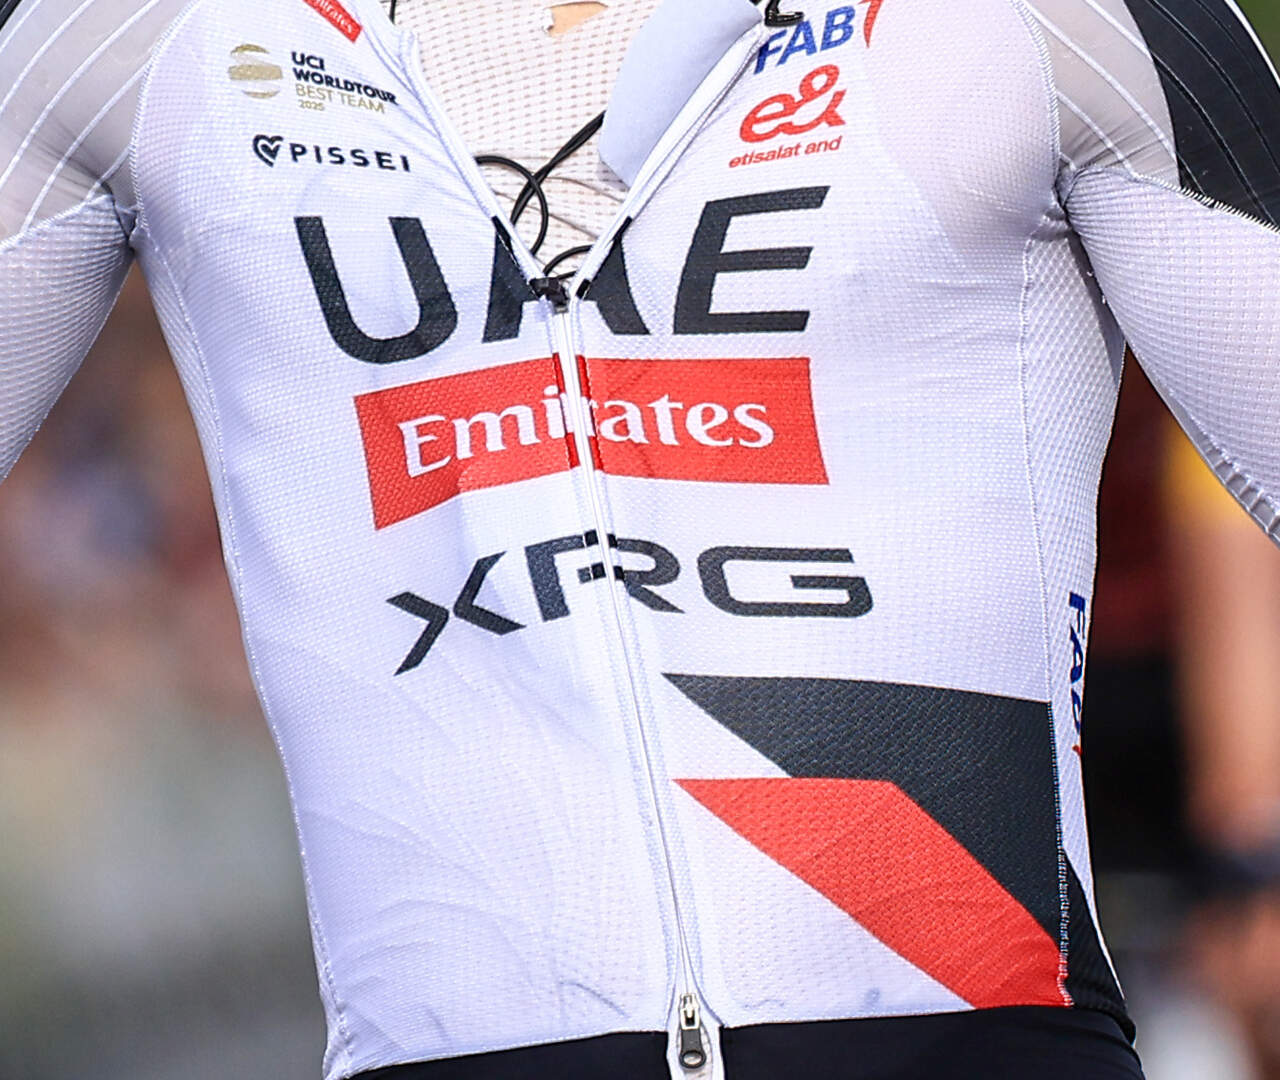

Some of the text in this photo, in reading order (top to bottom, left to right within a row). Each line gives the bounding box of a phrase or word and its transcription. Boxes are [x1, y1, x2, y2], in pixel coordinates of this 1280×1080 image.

[291, 51, 325, 71] UCI
[293, 67, 398, 105] WORLDTOUR
[295, 83, 384, 113] BEST TEAM
[290, 143, 410, 172] PISSEI
[729, 135, 843, 168] etisalat and
[294, 185, 831, 365] UAE
[396, 385, 775, 478] Emirates
[386, 531, 874, 676] XRG
